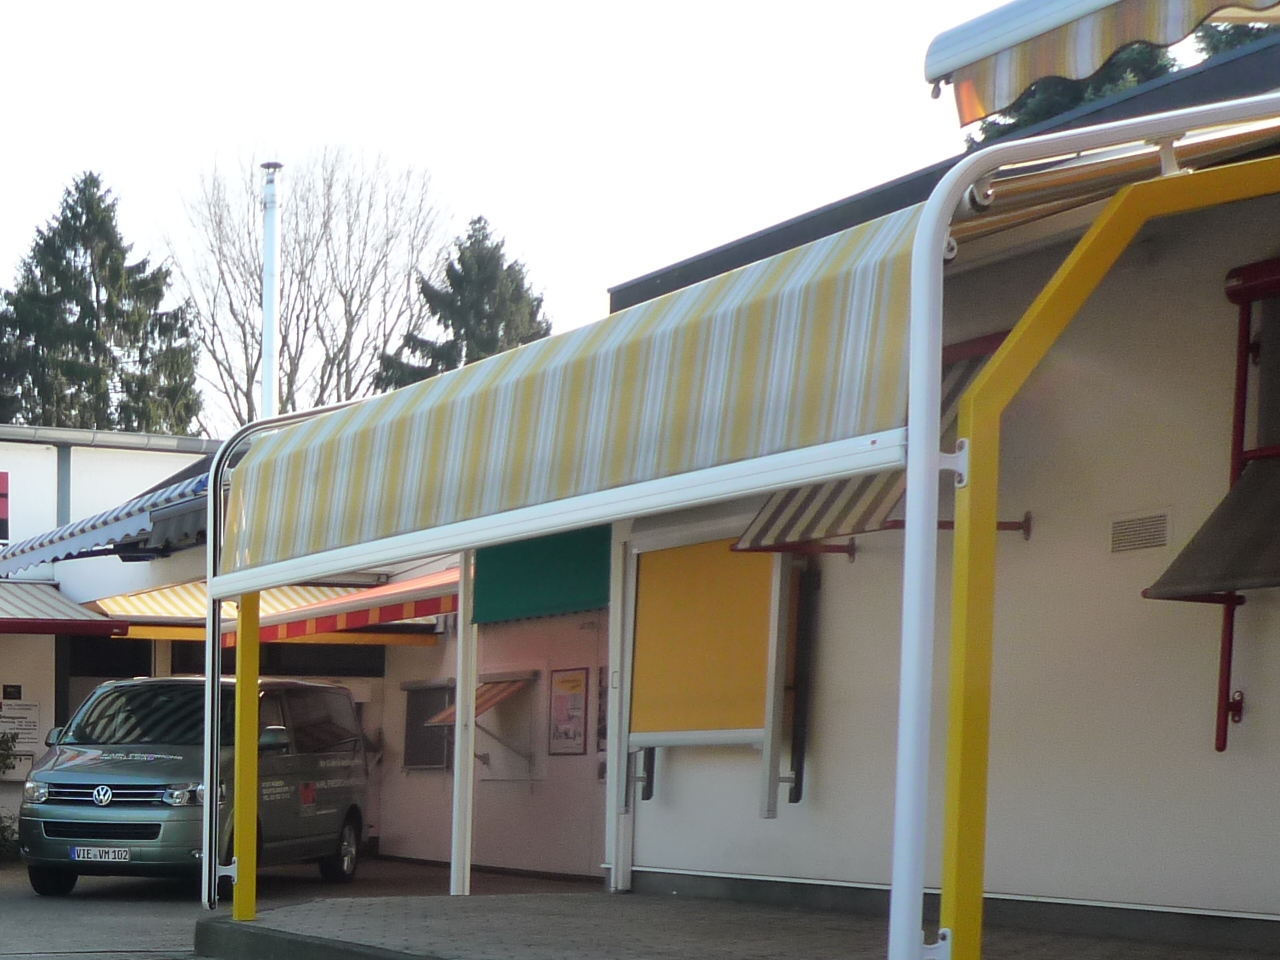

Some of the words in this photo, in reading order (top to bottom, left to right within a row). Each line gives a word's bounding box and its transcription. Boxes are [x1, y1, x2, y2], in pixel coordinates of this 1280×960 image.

[76, 849, 92, 859] VIE
[98, 849, 110, 860] VM
[111, 849, 128, 860] 102
